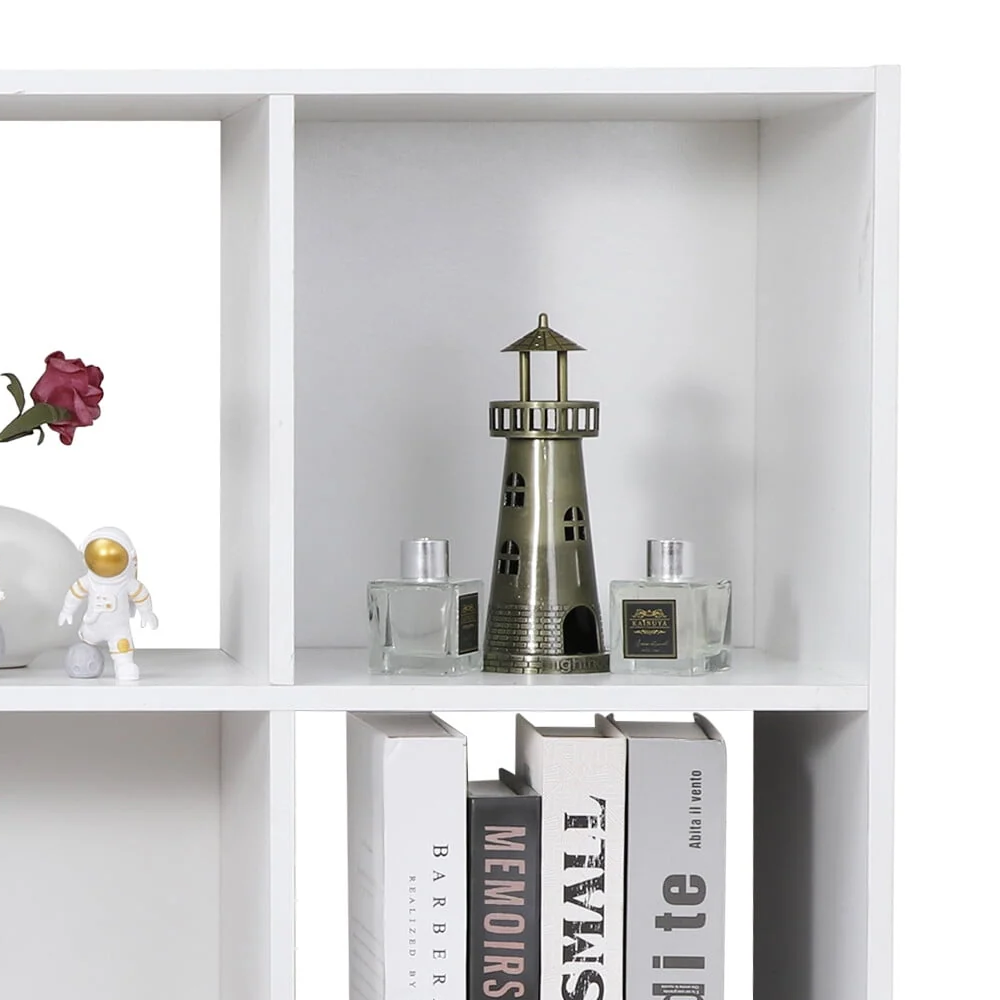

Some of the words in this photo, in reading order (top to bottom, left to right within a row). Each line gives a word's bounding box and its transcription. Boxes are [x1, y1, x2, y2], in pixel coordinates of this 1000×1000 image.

[689, 770, 702, 802] vento
[688, 819, 702, 849] Abita
[482, 825, 527, 999] MEMOIRS
[655, 874, 706, 932] te
